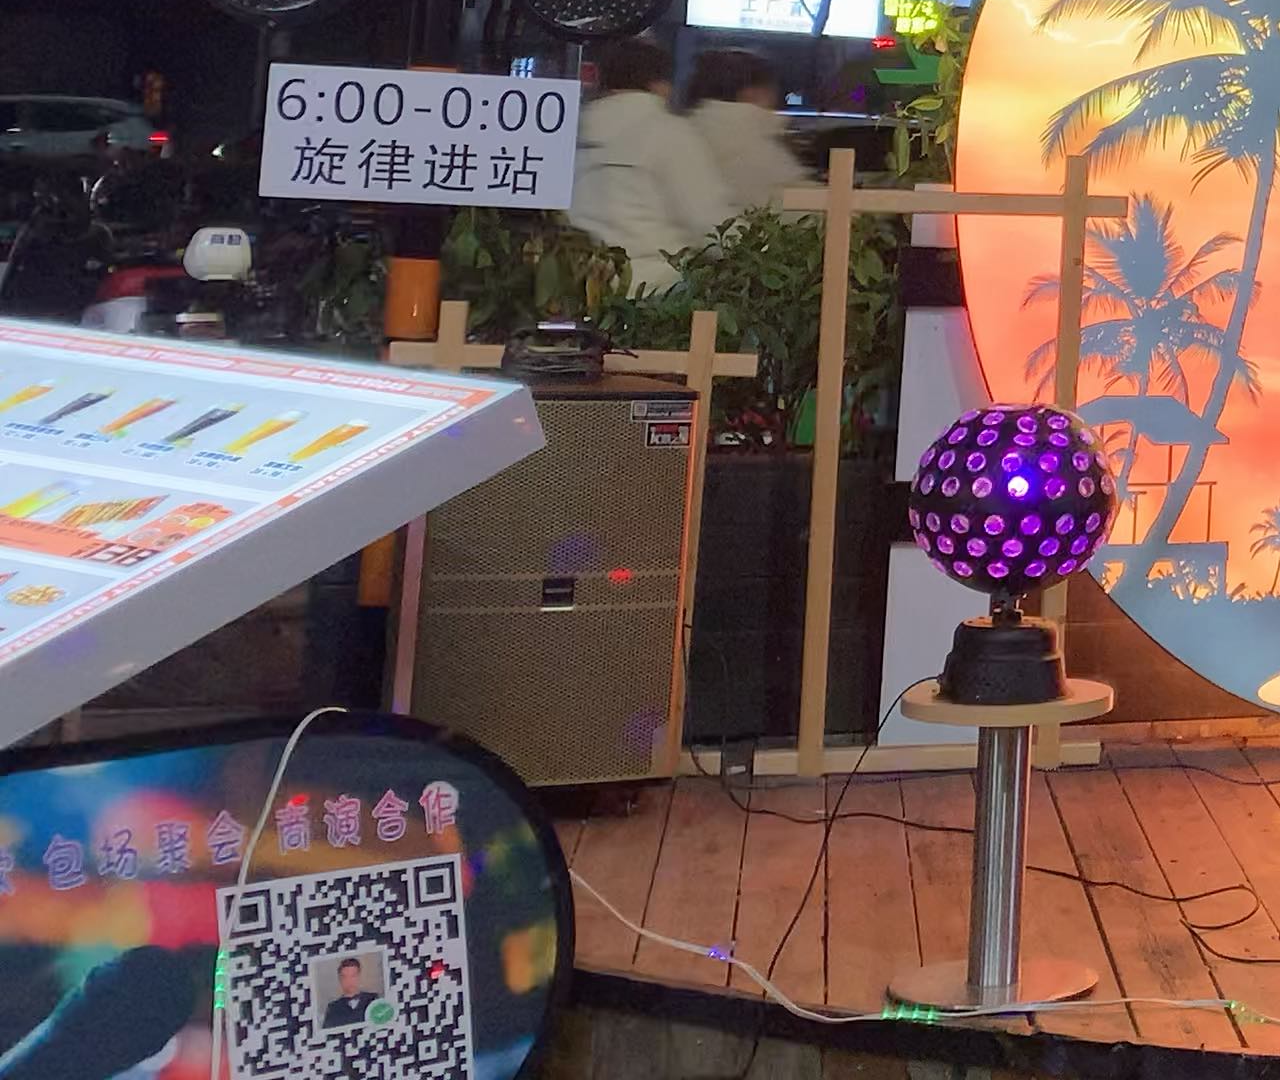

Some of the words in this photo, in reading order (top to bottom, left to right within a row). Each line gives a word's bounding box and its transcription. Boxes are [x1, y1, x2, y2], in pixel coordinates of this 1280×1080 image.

[276, 78, 566, 134] 6:00-0:00
[290, 136, 545, 196] 旋律进站
